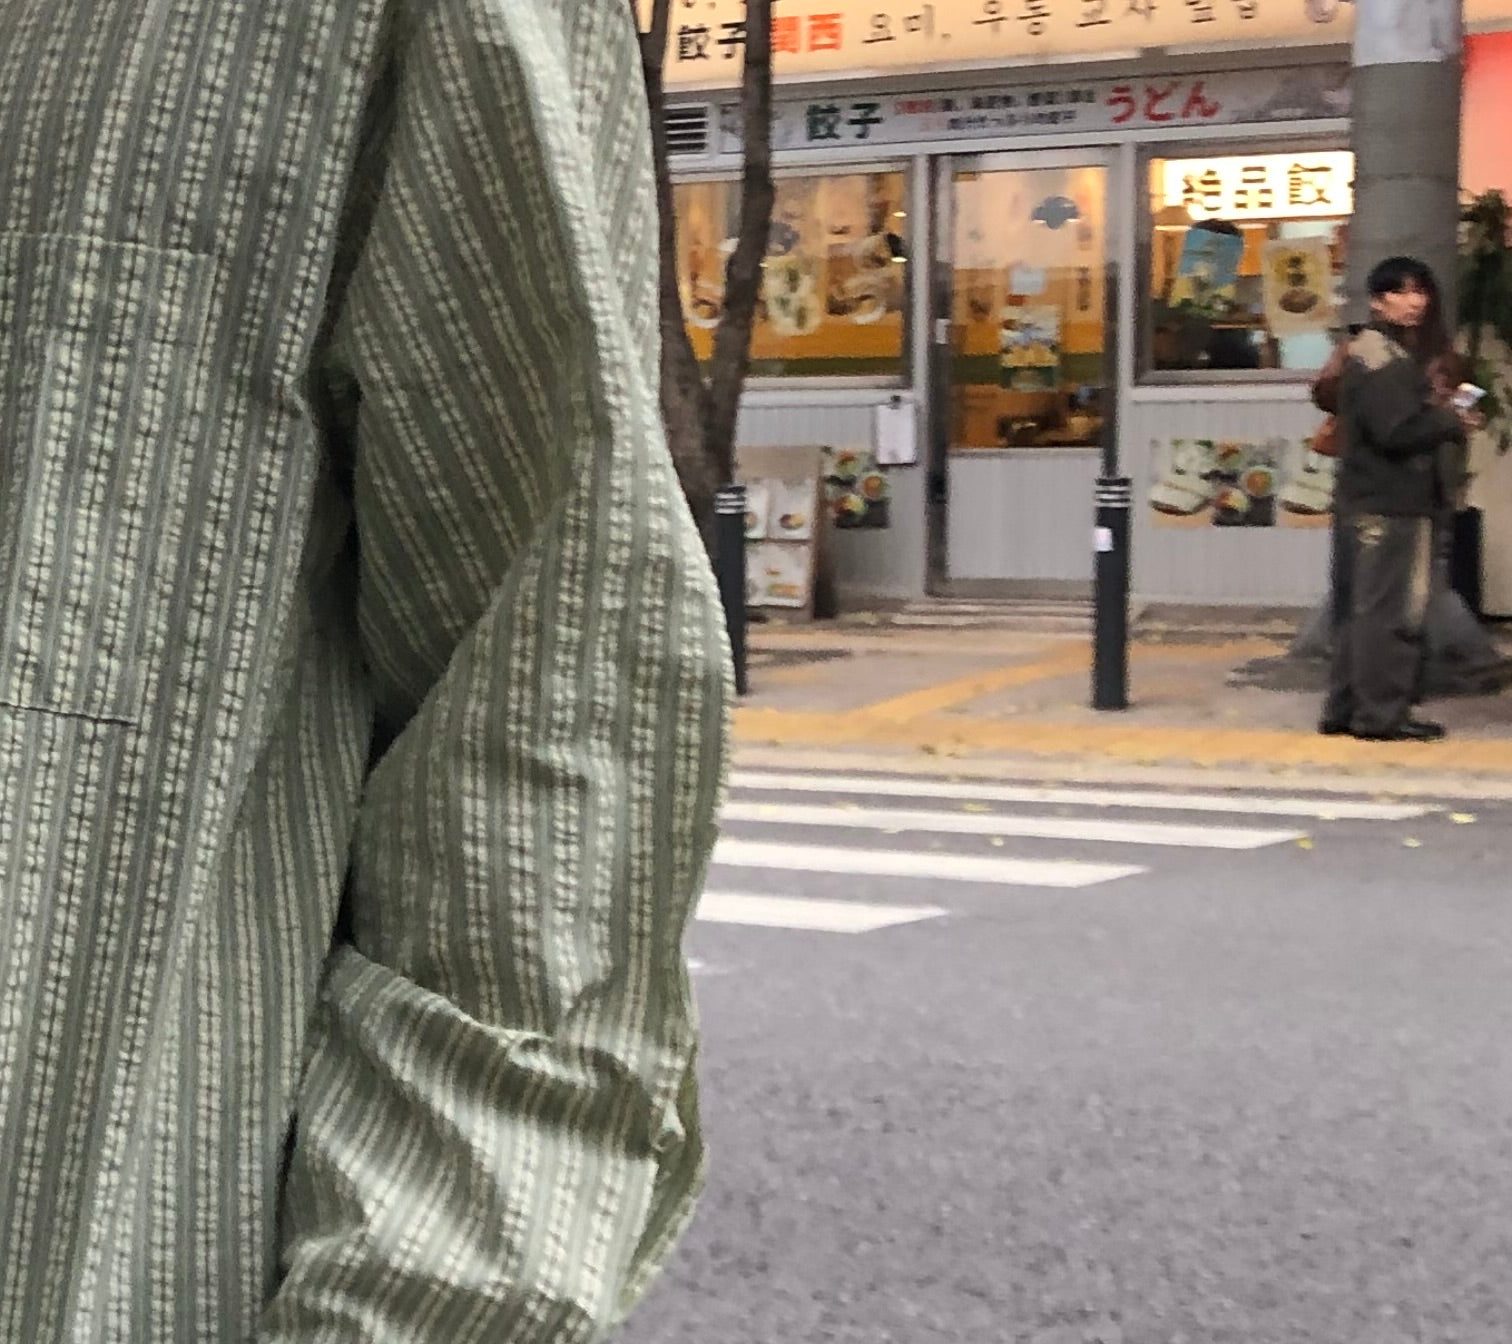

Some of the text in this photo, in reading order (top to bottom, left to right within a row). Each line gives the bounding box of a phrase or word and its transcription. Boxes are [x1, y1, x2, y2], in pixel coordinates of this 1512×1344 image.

[1105, 79, 1222, 125] うどん
[1181, 162, 1355, 213] 絶品餃
